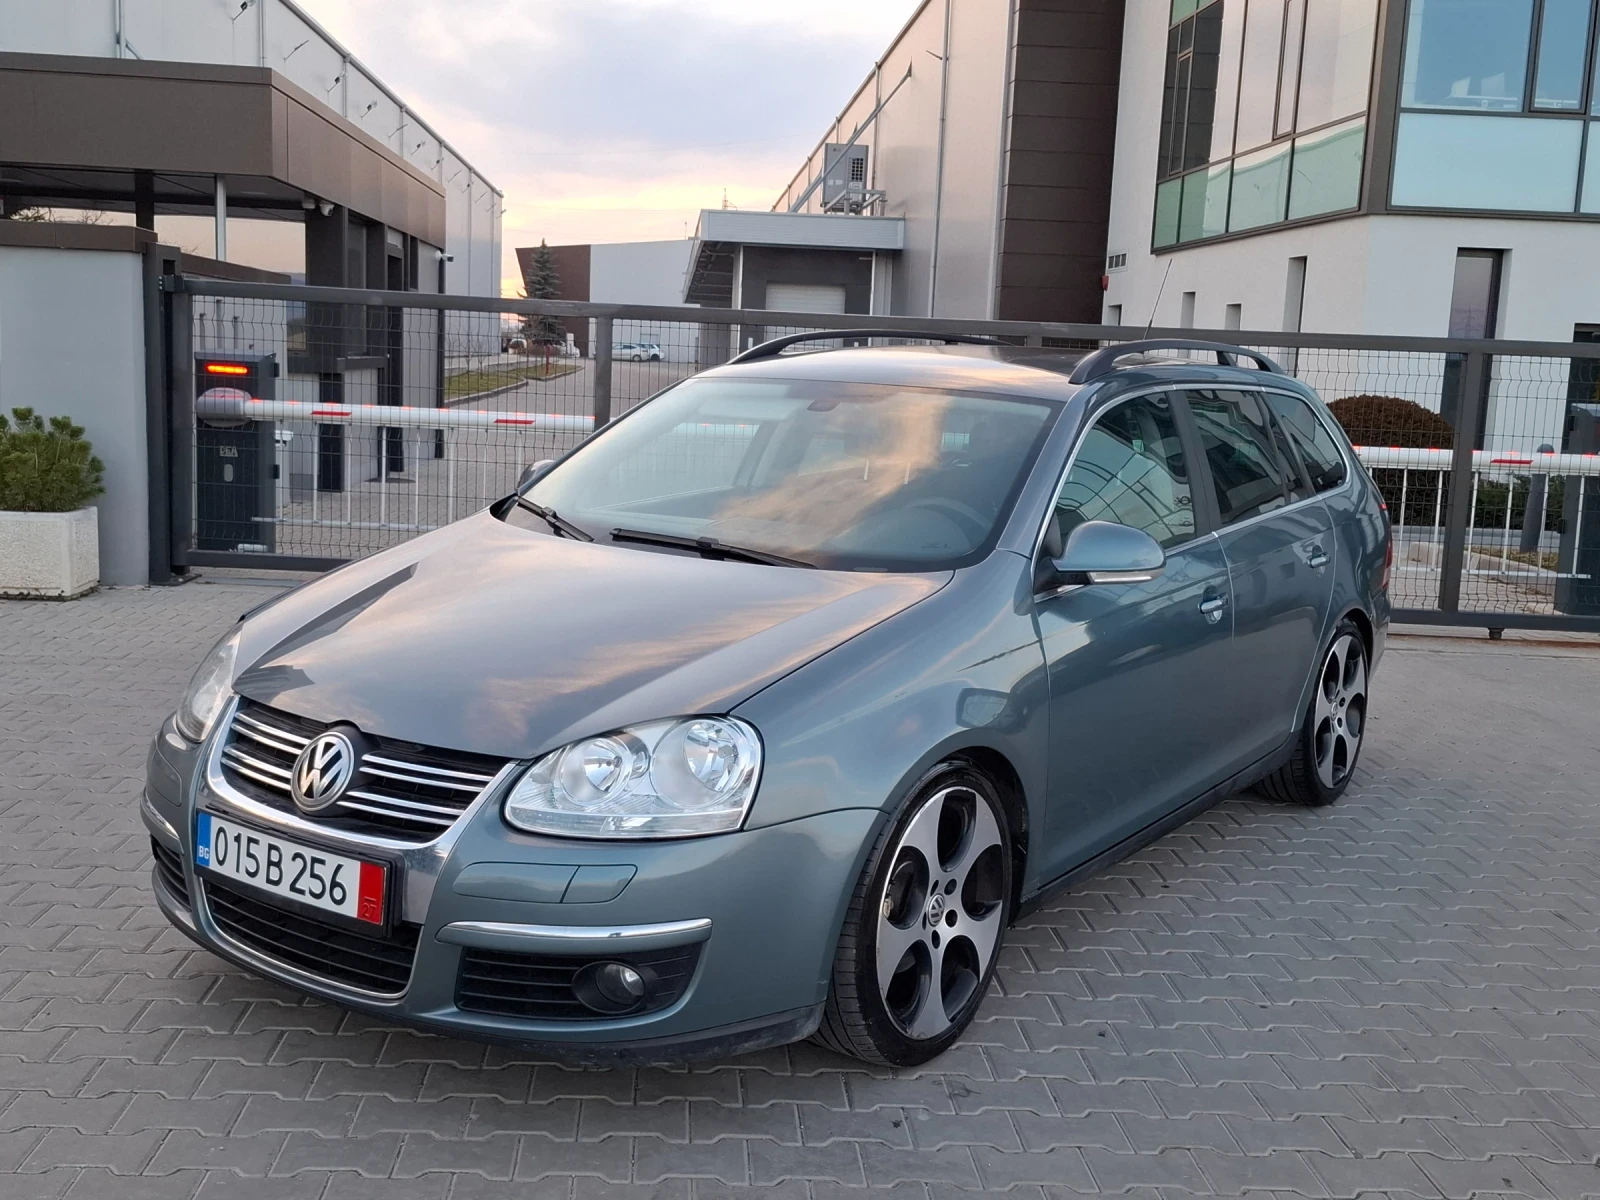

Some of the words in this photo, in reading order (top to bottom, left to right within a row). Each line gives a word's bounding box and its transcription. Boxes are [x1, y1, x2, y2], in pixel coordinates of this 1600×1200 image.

[295, 734, 350, 806] VW
[198, 845, 210, 859] BG
[215, 826, 347, 905] 015B256
[362, 902, 377, 920] 27
